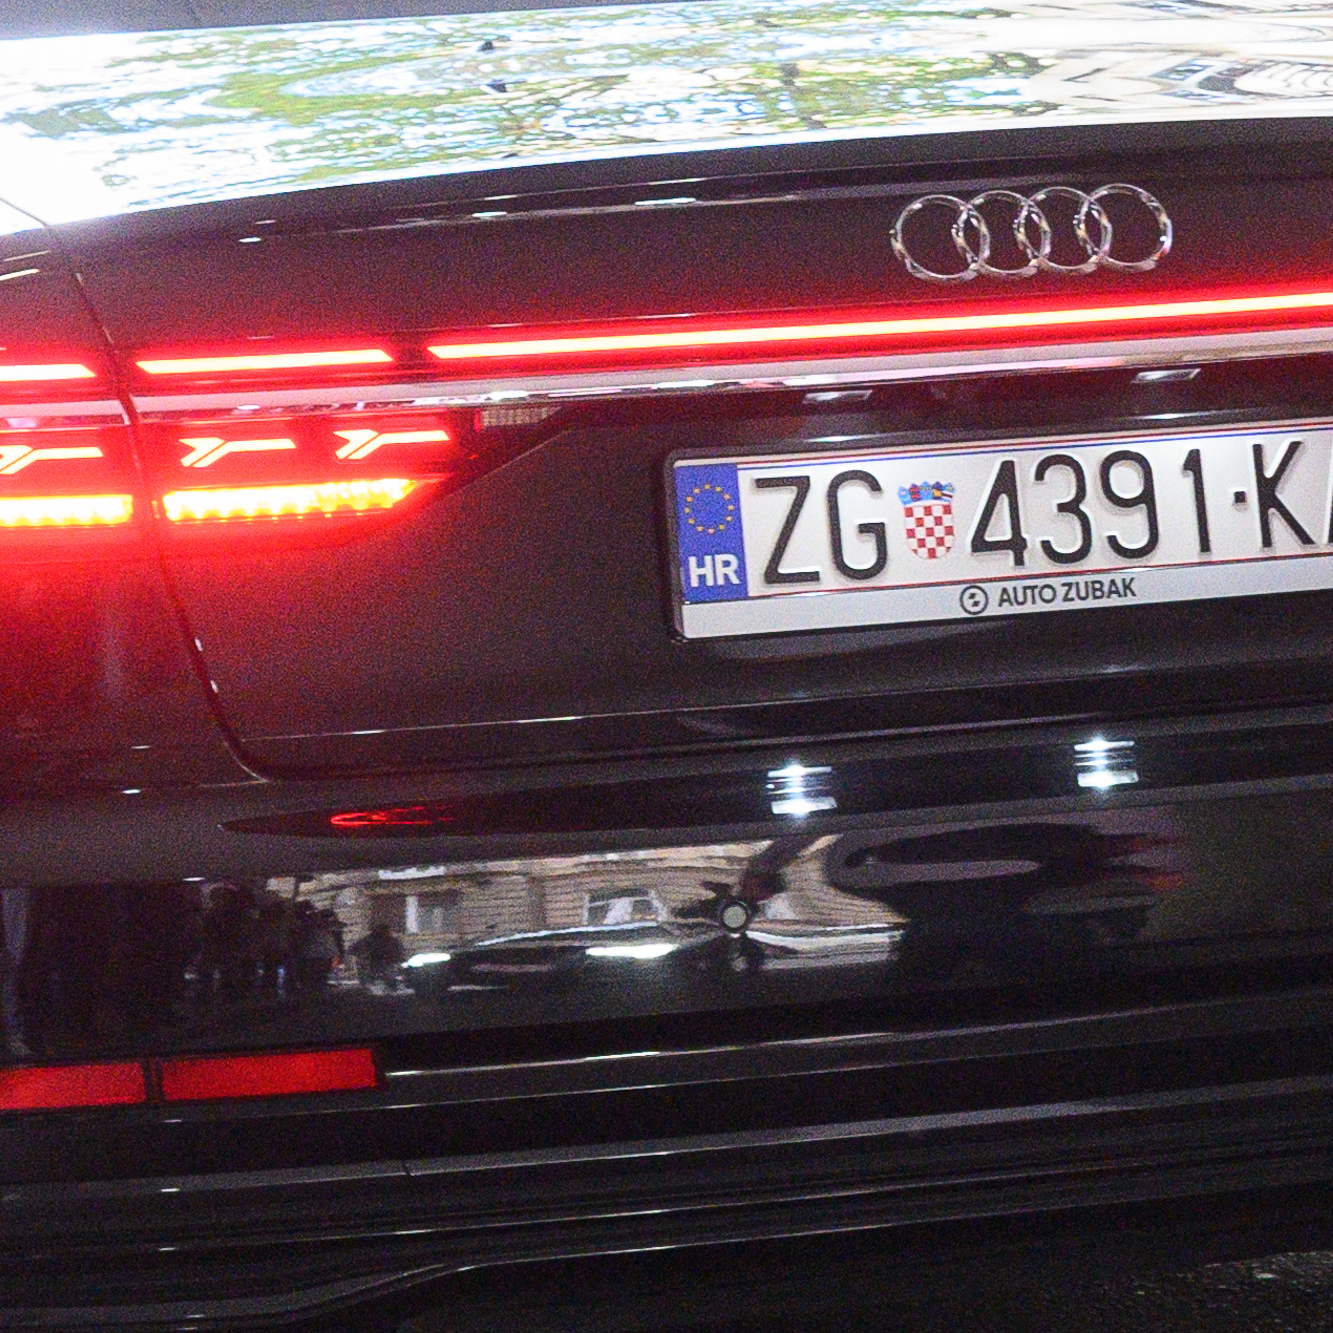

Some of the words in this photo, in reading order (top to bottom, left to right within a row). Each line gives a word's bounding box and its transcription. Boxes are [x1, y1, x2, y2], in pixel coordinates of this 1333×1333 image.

[754, 470, 888, 585] ZG
[687, 555, 740, 589] HR
[997, 584, 1057, 608] AUTO
[1061, 577, 1137, 603] ZUBAK
